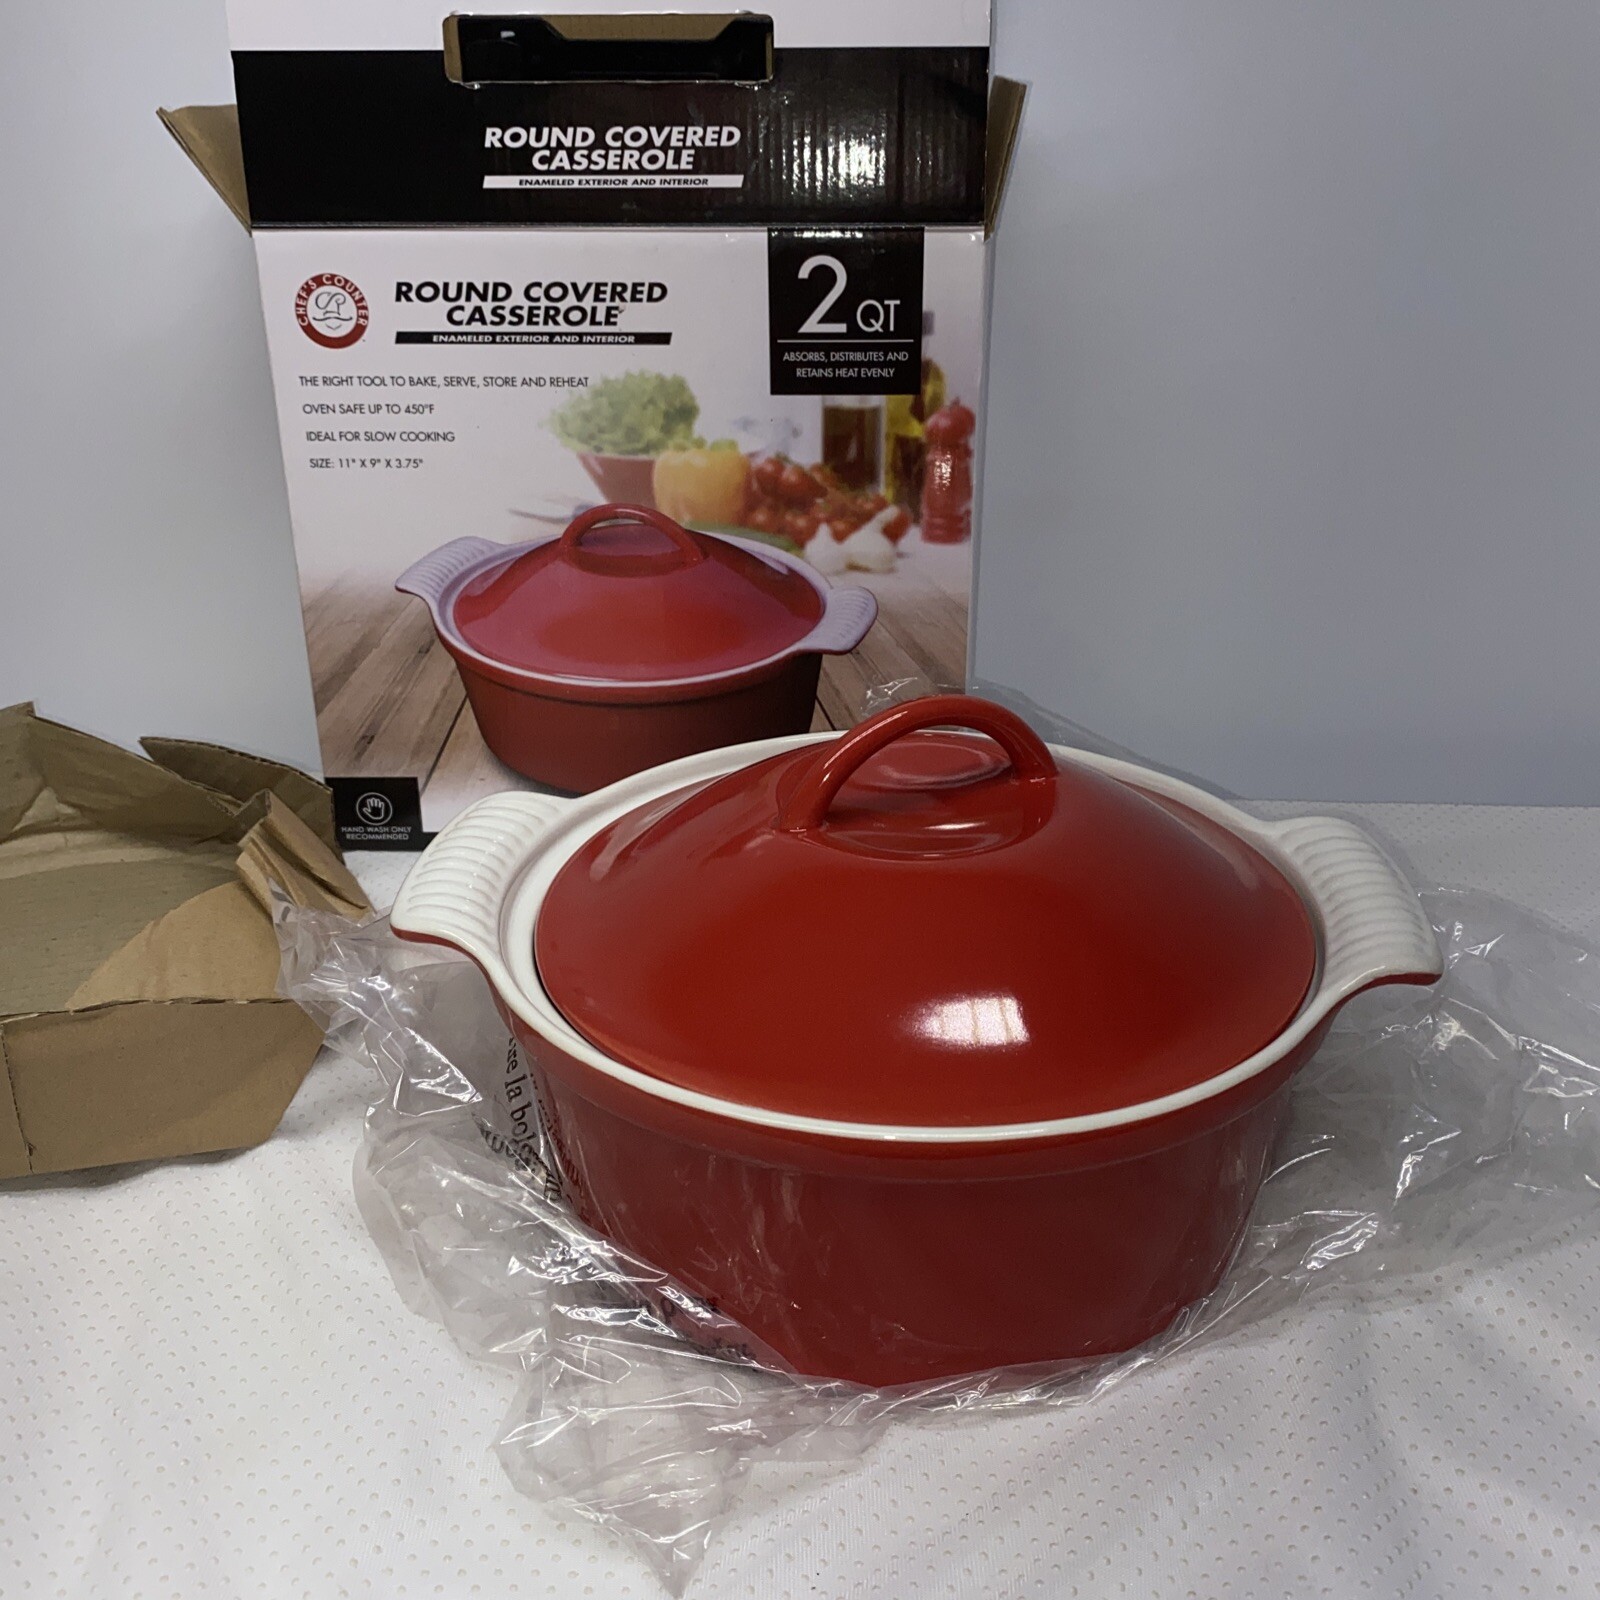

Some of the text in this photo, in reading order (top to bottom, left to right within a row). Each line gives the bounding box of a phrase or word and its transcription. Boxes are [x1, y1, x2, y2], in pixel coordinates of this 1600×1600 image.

[484, 125, 741, 148] ROUND COVERED
[531, 149, 696, 171] CASSEROLE
[518, 177, 709, 187] ENAMELED EXTERIOR AND INTERIOR
[394, 281, 669, 303] ROUND COVERED
[797, 254, 901, 334] 2 QT
[296, 273, 369, 327] CHEF'S COUNTER
[446, 305, 620, 327] CASSEROLE
[432, 334, 636, 344] ENAMELED EXTERIOR AND INTERIOR
[782, 351, 909, 363] ABSORBS, DISTRIBUTES AND
[795, 367, 896, 378] RETAINS HEAT EVENLY
[298, 376, 589, 389] THE RIGHT TOOL TO BAKE, SERVE, STORE AND REHEAT
[302, 404, 336, 415] OVEN
[339, 404, 366, 415] SAFE
[368, 404, 383, 415] UP
[384, 404, 402, 415] TO
[306, 431, 456, 443] IDEAL FOR SLOW COOKING
[309, 458, 335, 469] SIZE:
[359, 458, 368, 469] X
[384, 458, 393, 469] X
